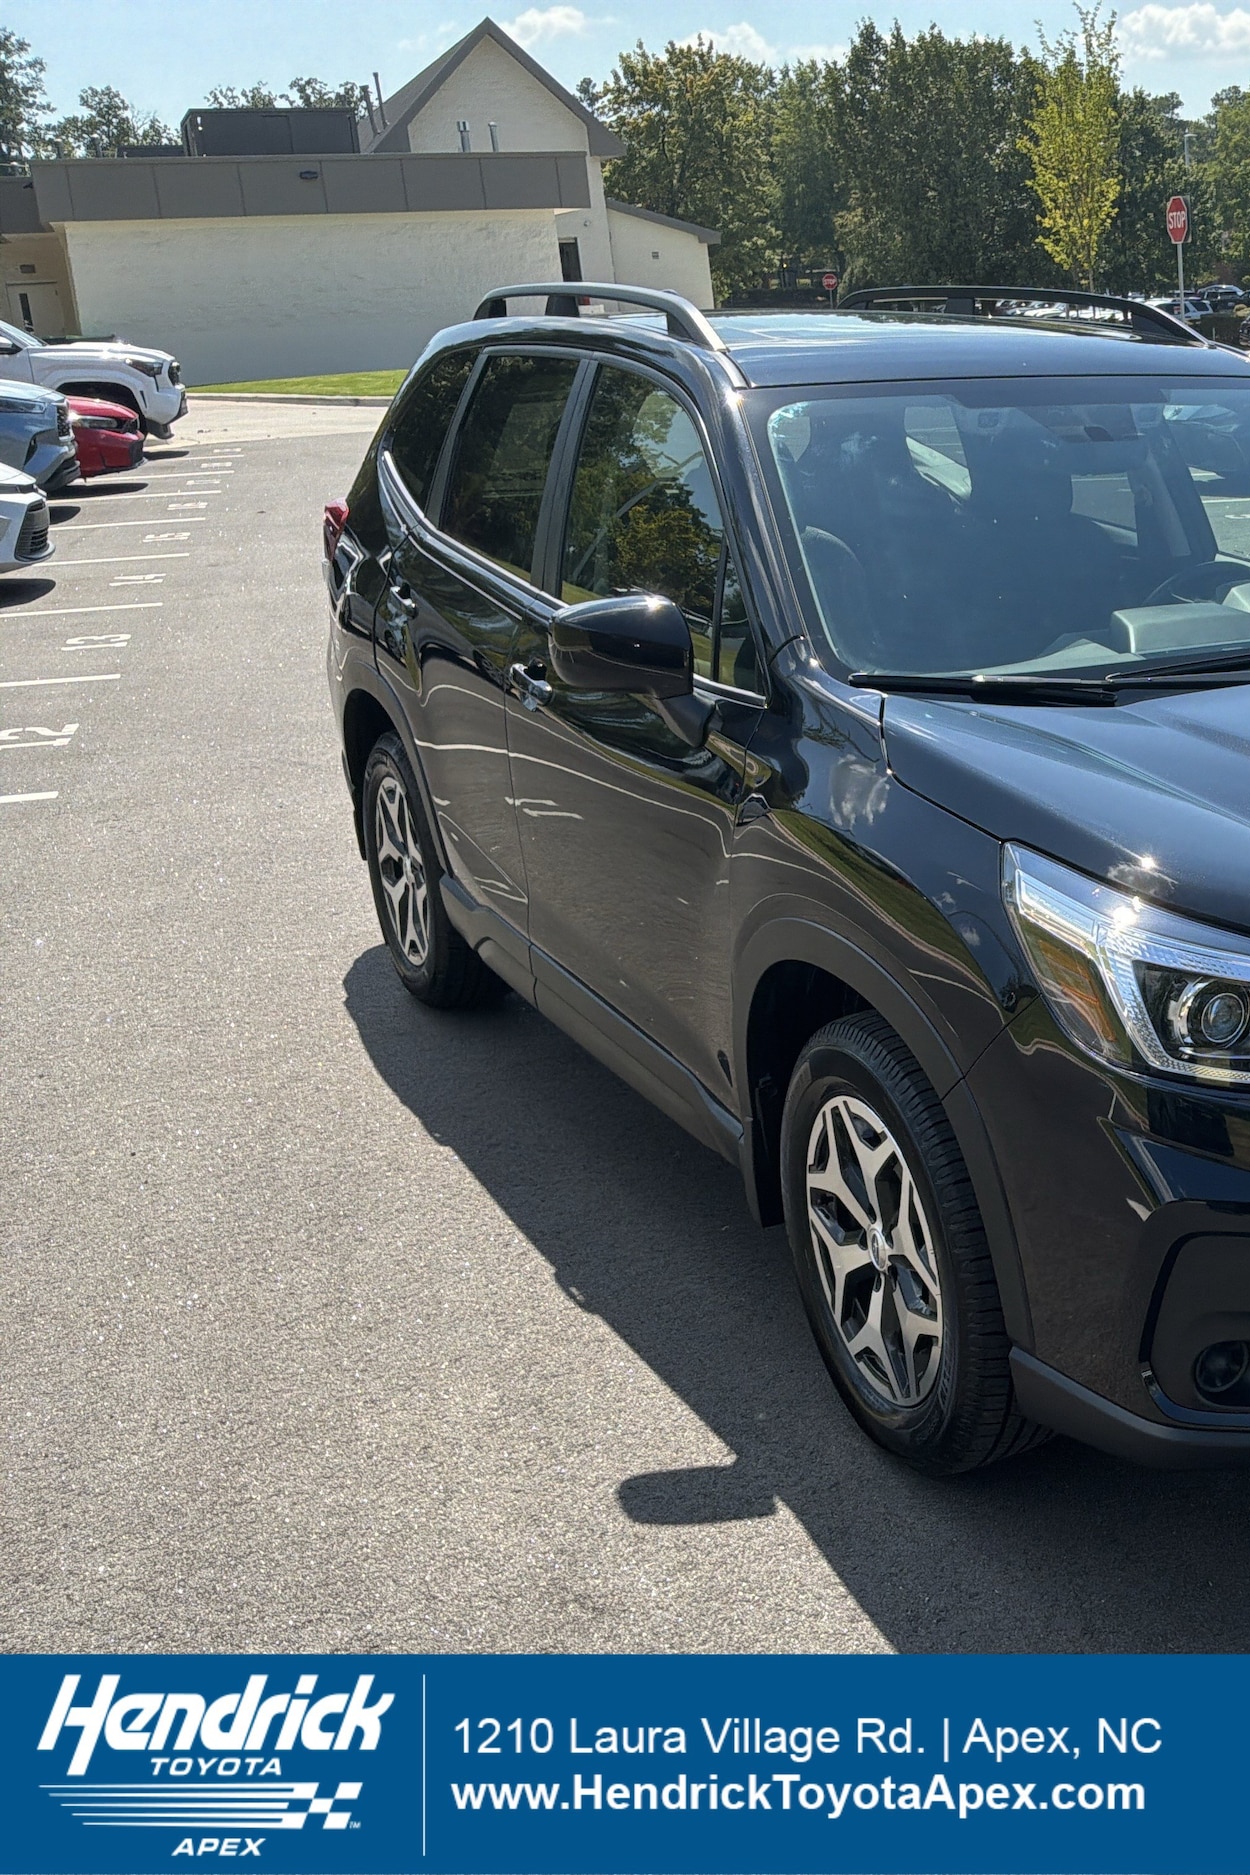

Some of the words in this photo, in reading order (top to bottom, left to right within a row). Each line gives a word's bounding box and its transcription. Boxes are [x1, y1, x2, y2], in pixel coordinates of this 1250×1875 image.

[1168, 211, 1186, 229] STOP
[109, 573, 167, 586] 14
[61, 633, 132, 651] 13
[0, 723, 79, 749] 12
